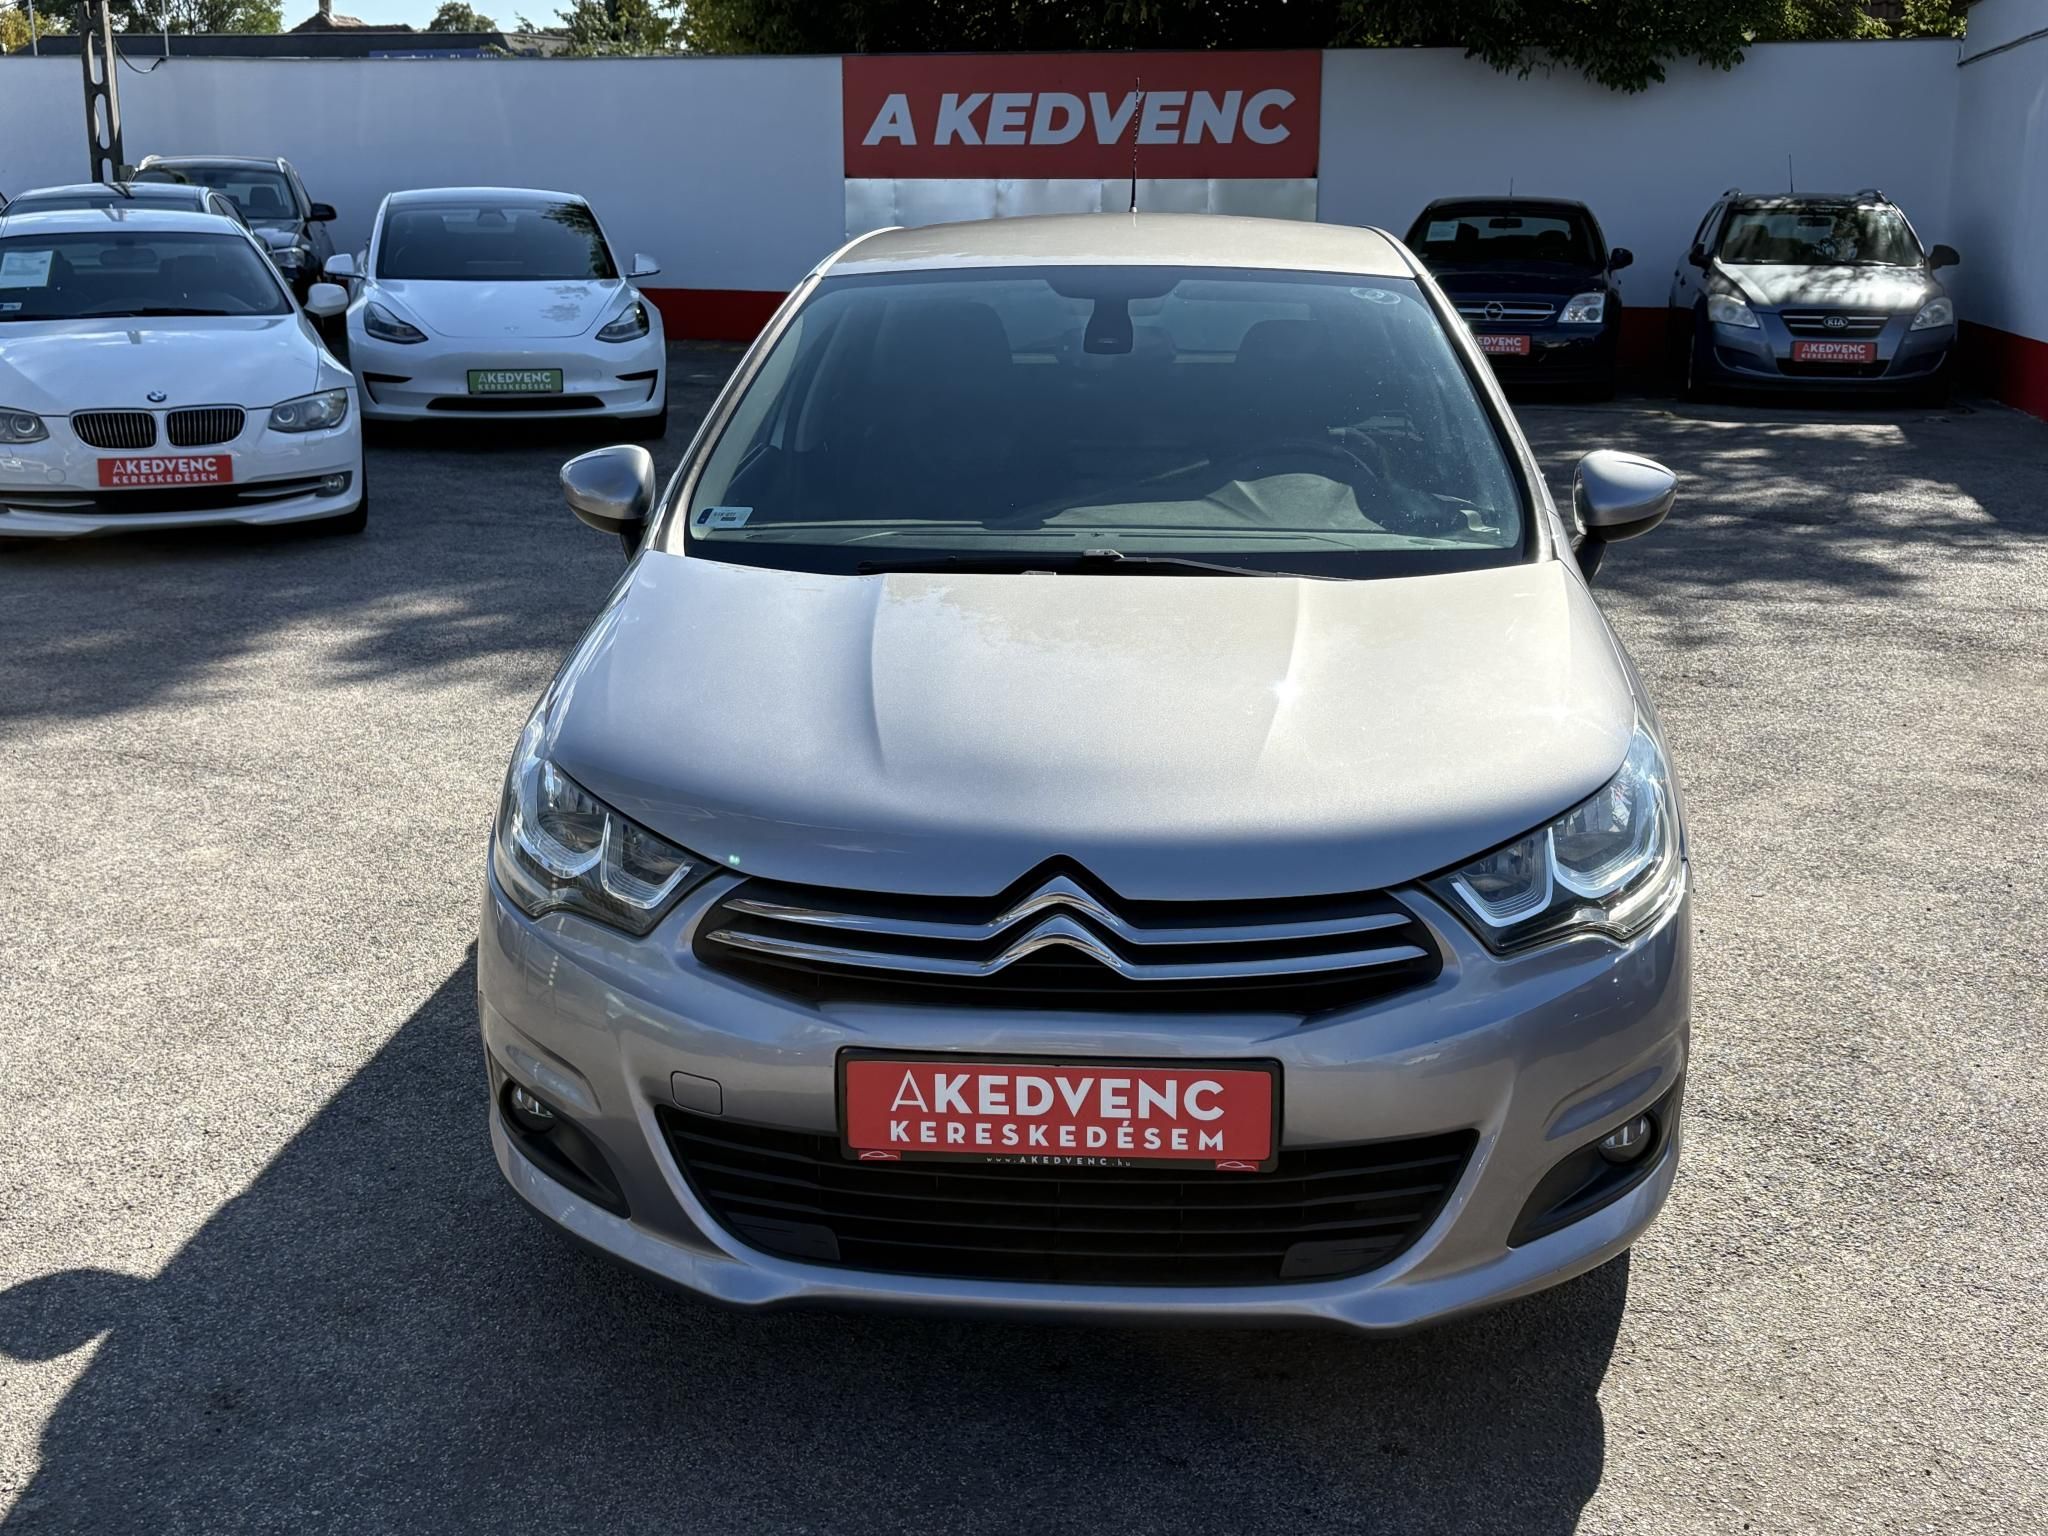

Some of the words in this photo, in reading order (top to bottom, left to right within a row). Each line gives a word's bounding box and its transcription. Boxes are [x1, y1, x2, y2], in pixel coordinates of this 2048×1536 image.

[862, 93, 918, 146] A
[934, 88, 1297, 145] KEDVENC
[1827, 319, 1845, 327] KIA
[1477, 336, 1522, 346] EDVENC
[112, 458, 217, 474] AKEDVENC
[112, 473, 218, 484] KERESKEDÉSEM
[890, 1069, 1225, 1121] AKEDVENC
[890, 1120, 1225, 1152] KERESKEDÉSEM
[986, 1156, 1132, 1167] www.AKEDVENC.hu
